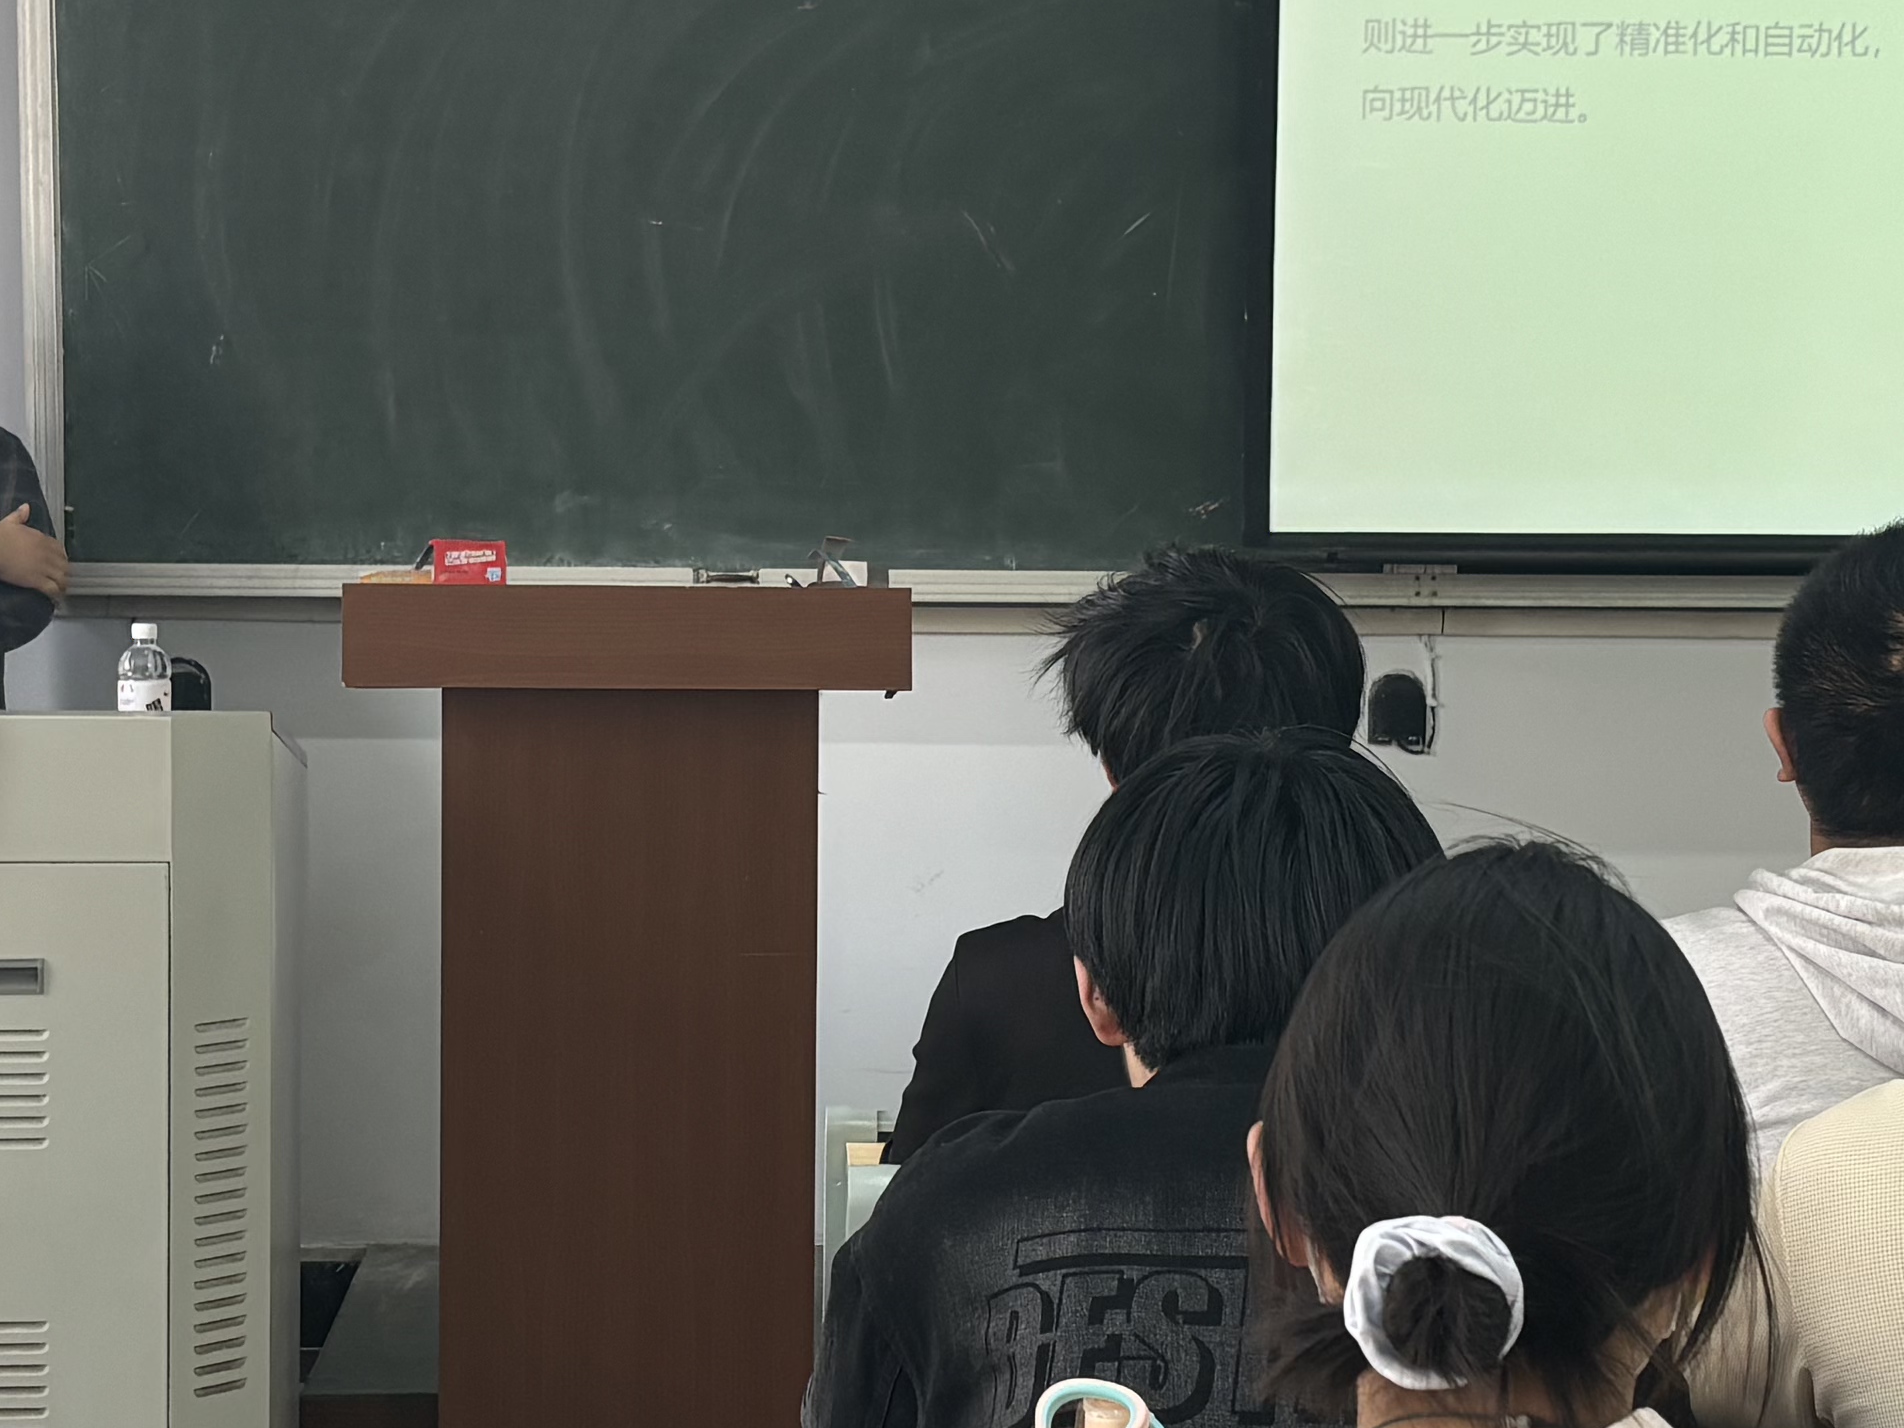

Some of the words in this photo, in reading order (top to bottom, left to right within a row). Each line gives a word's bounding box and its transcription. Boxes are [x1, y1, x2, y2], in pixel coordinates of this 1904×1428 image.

[1361, 85, 1588, 124] 向现代化迈进。
